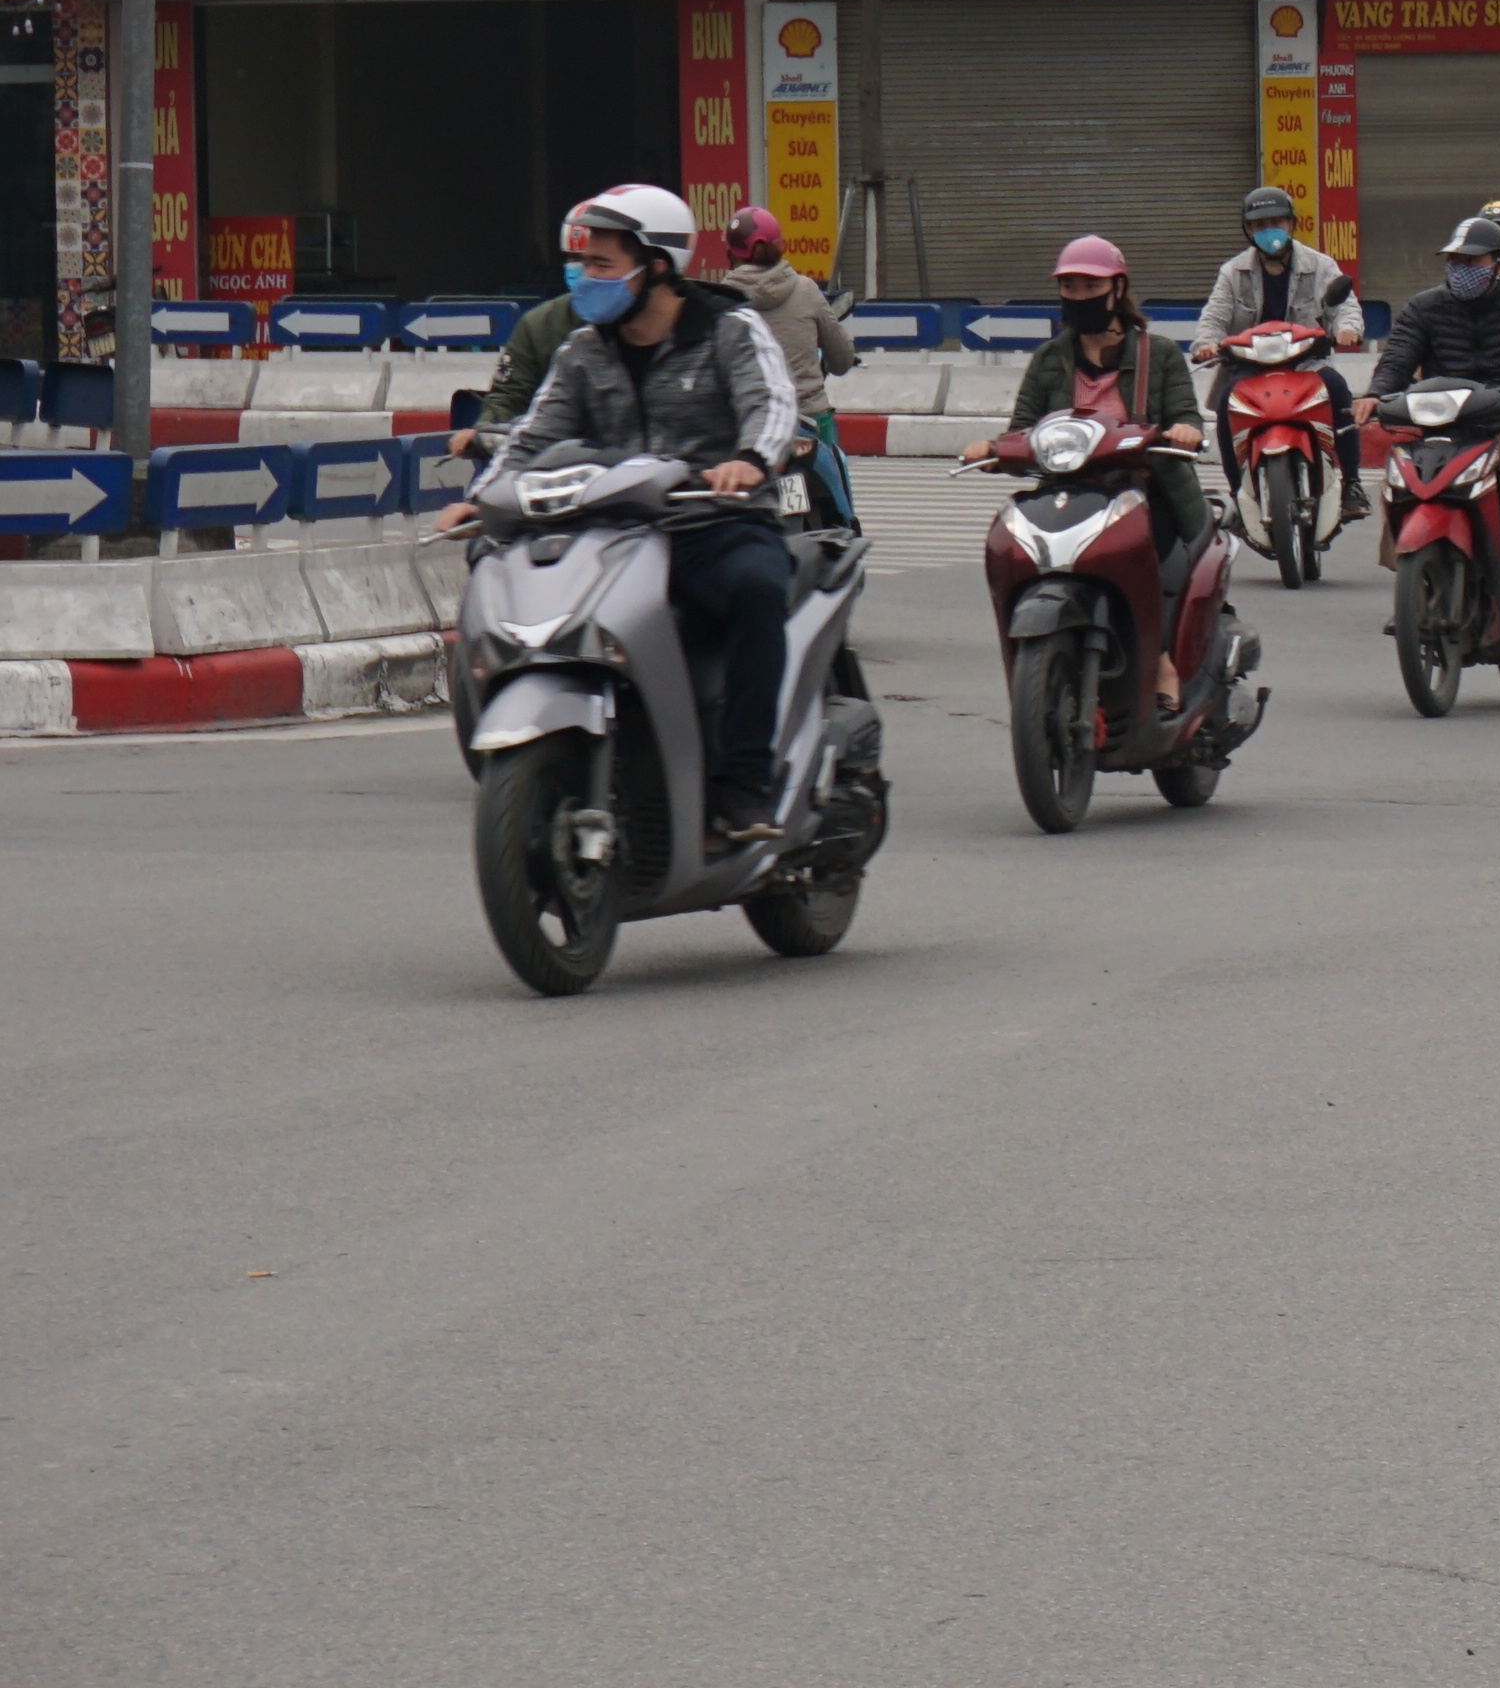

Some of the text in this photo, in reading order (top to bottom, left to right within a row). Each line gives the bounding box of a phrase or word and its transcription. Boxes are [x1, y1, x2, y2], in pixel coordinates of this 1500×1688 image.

[692, 0, 734, 61] BÚN
[1400, 0, 1477, 28] TRANG
[153, 89, 180, 155] HẢ
[694, 80, 735, 146] CHẢ
[152, 192, 188, 253] GỌC
[688, 182, 742, 241] NGỌC
[1322, 215, 1358, 262] VÀNG
[251, 218, 295, 270] CHẢ
[208, 273, 288, 296] NGỌC ÁNH
